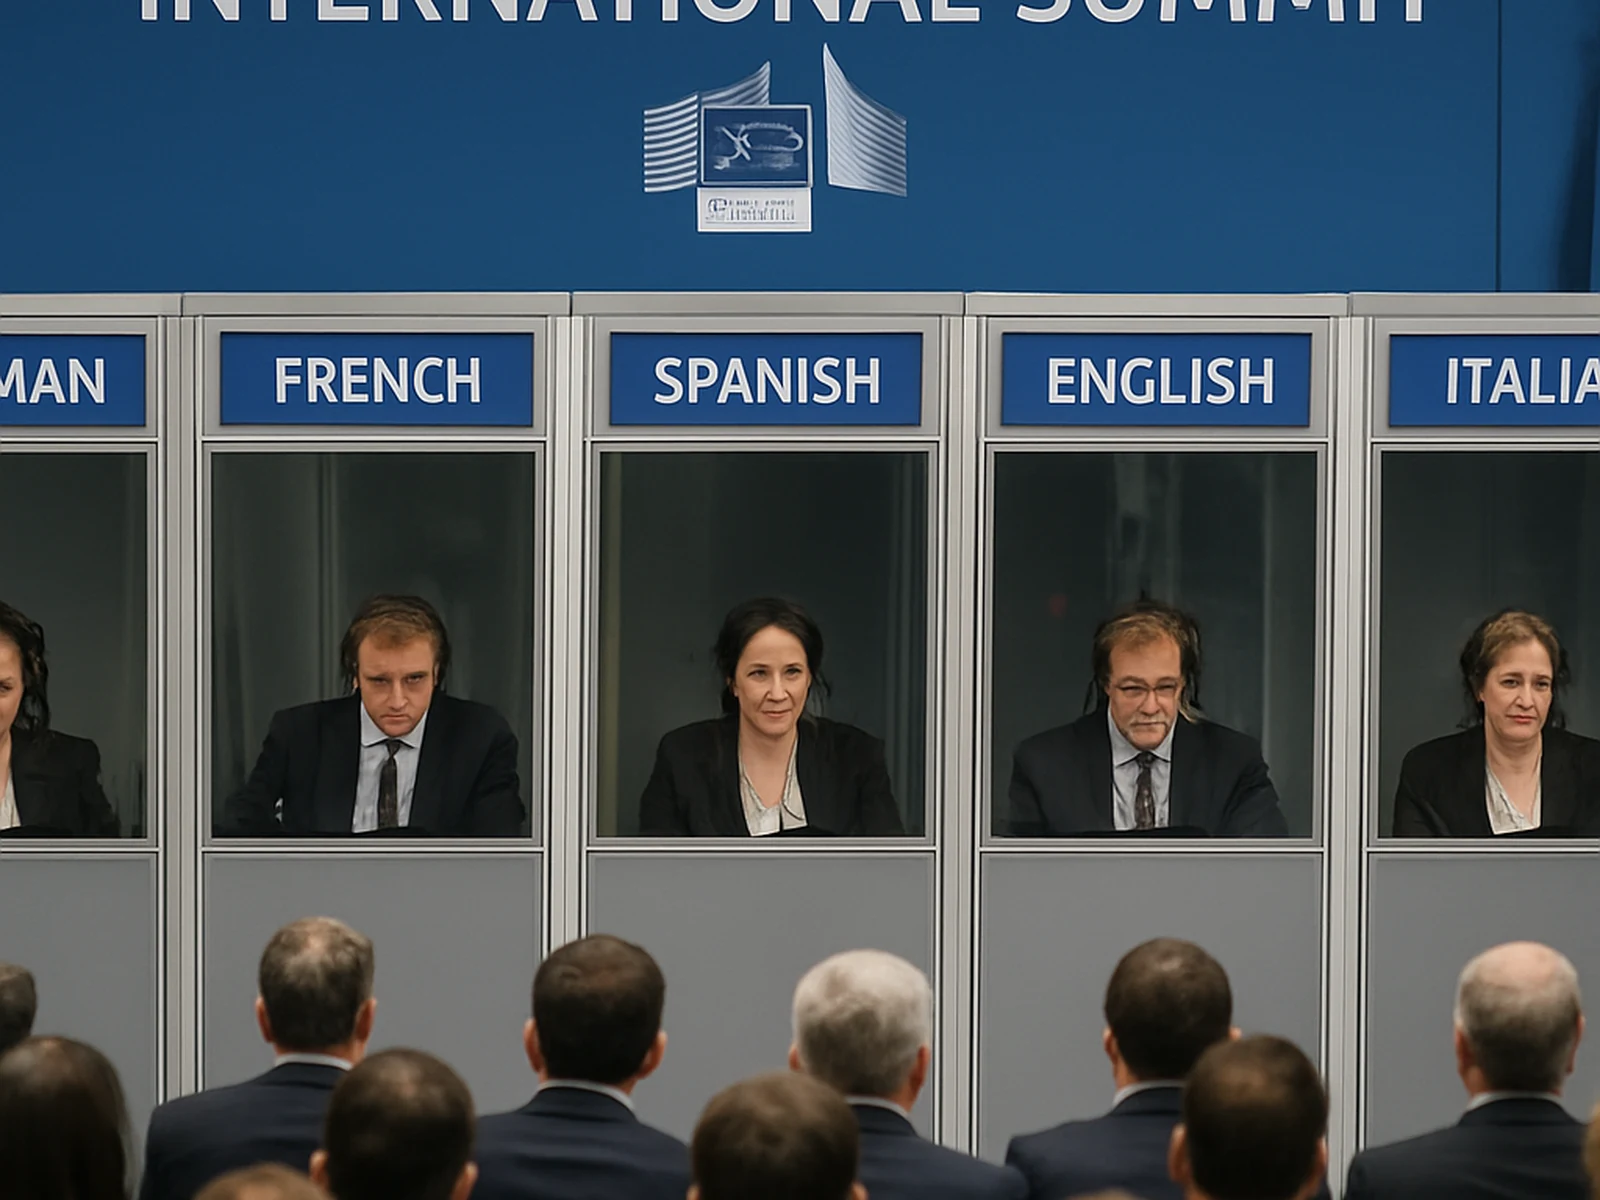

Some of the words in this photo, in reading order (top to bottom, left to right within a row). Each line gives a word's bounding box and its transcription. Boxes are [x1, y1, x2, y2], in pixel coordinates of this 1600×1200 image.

[275, 356, 481, 404] FRENCH
[653, 356, 880, 405] SPANISH
[1048, 356, 1275, 405] ENGLISH
[1446, 357, 1600, 404] ITALIA
